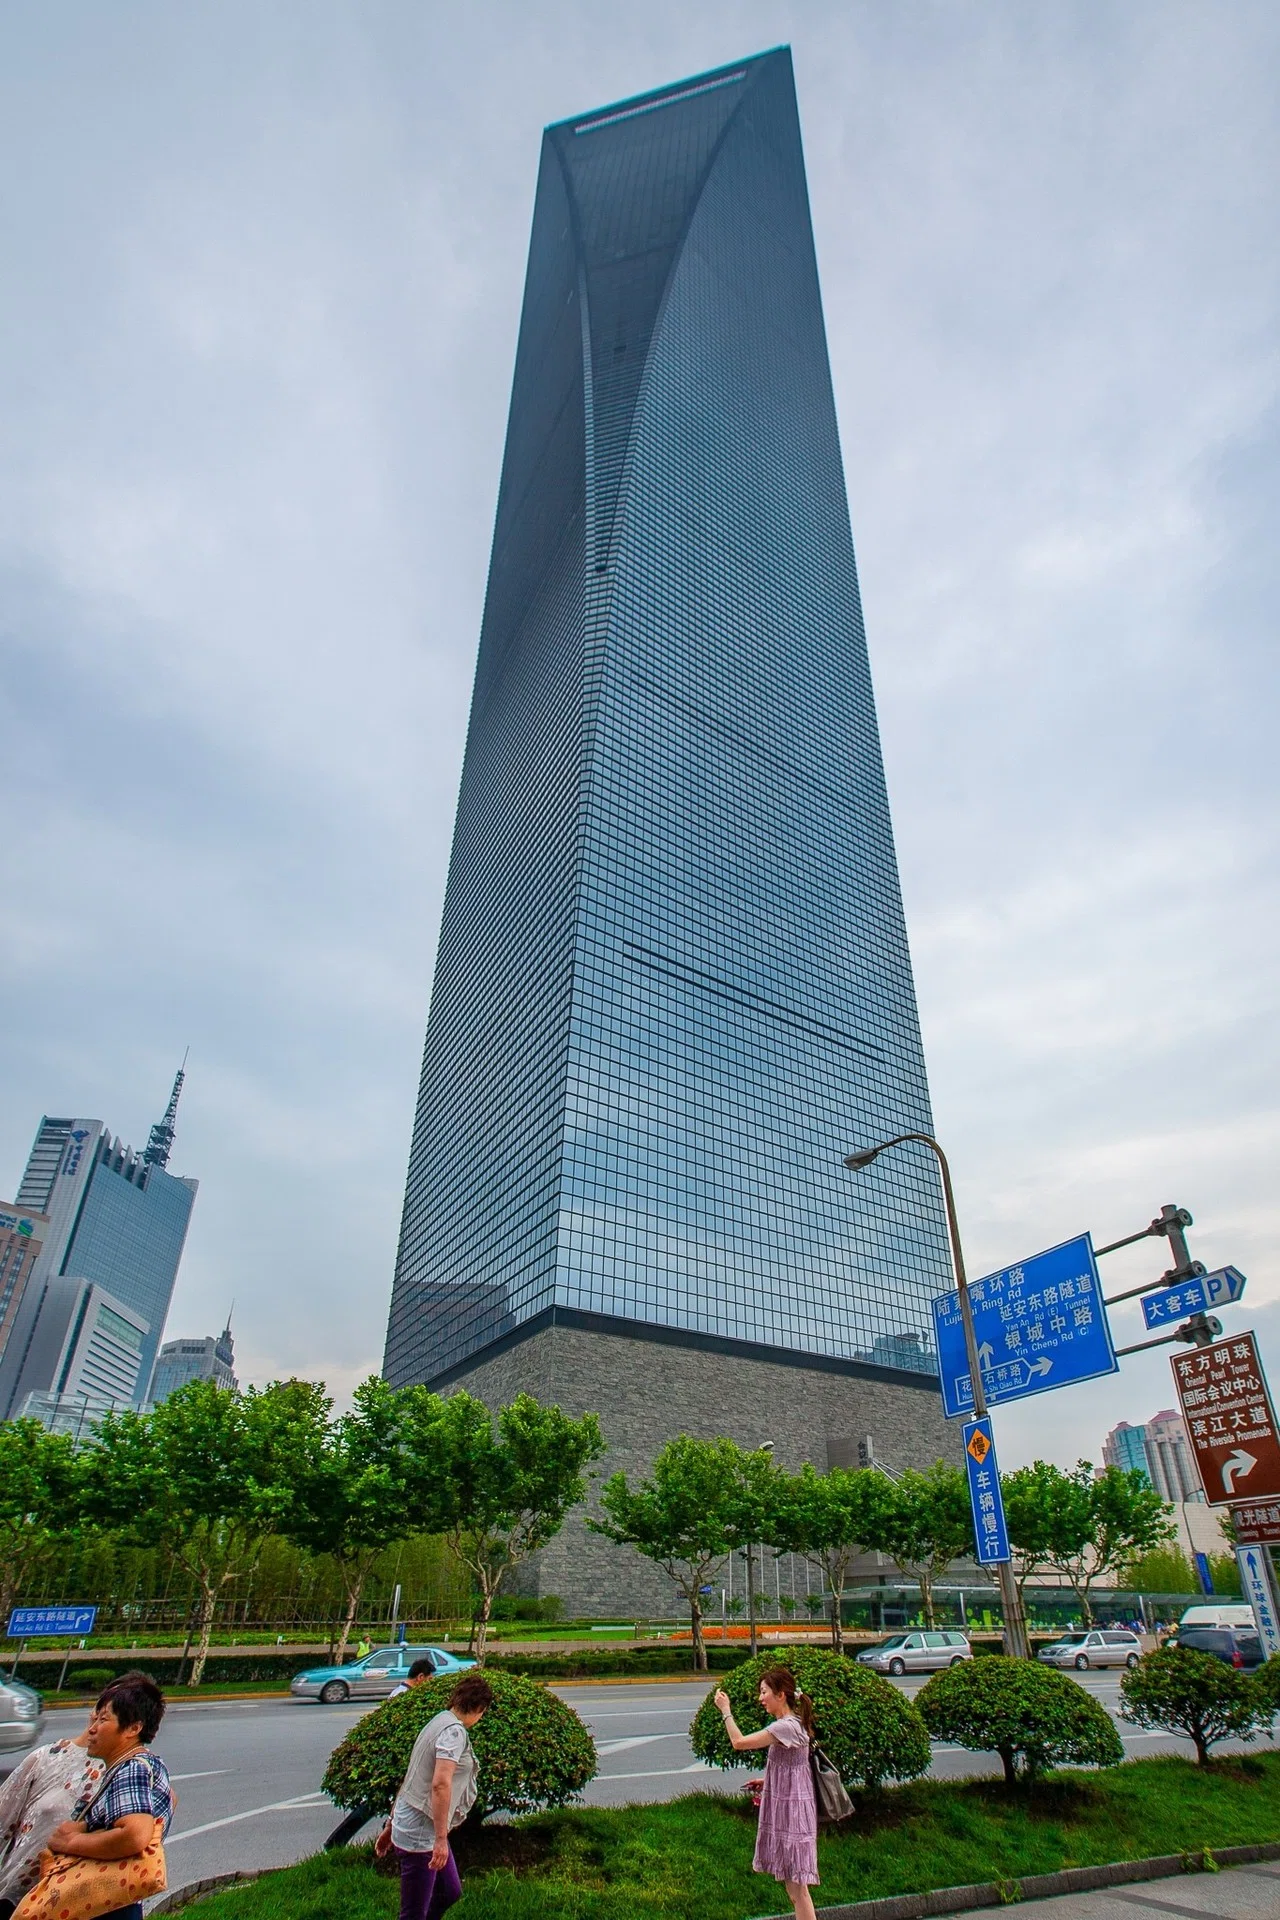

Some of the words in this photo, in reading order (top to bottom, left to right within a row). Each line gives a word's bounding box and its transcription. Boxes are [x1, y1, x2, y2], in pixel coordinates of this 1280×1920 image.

[981, 1296, 1003, 1312] Ring
[1008, 1288, 1022, 1302] Rd
[1000, 1273, 1093, 1323] 延安东路隧道
[1034, 1311, 1045, 1322] Rd
[1048, 1306, 1059, 1317] (E)
[1064, 1295, 1091, 1311] Tunnel
[1148, 1288, 1202, 1320] 大客车
[1207, 1278, 1222, 1301] P
[1004, 1306, 1093, 1350] 银城中路
[1014, 1348, 1029, 1357] Yin
[1031, 1338, 1059, 1351] Cheng
[1061, 1331, 1074, 1342] Rd
[1178, 1343, 1251, 1376] 东方明珠
[961, 1364, 1021, 1392] 花石桥路
[1014, 1377, 1023, 1385] Rd
[1185, 1373, 1207, 1388] Oriental
[1210, 1368, 1226, 1381] Pearl
[1230, 1363, 1250, 1375] Tower
[1183, 1375, 1260, 1407] 国际会议中心
[1187, 1403, 1217, 1419] International
[1217, 1397, 1246, 1412] Convention
[1245, 1393, 1265, 1405] Center
[1192, 1405, 1268, 1436] 滨江大道
[972, 1436, 985, 1456] 慢
[1196, 1438, 1208, 1449] The
[1209, 1432, 1235, 1447] Riverside
[1236, 1425, 1272, 1441] Promenade
[976, 1470, 999, 1557] 车辆慢行
[1251, 1580, 1278, 1651] 环球金融中心
